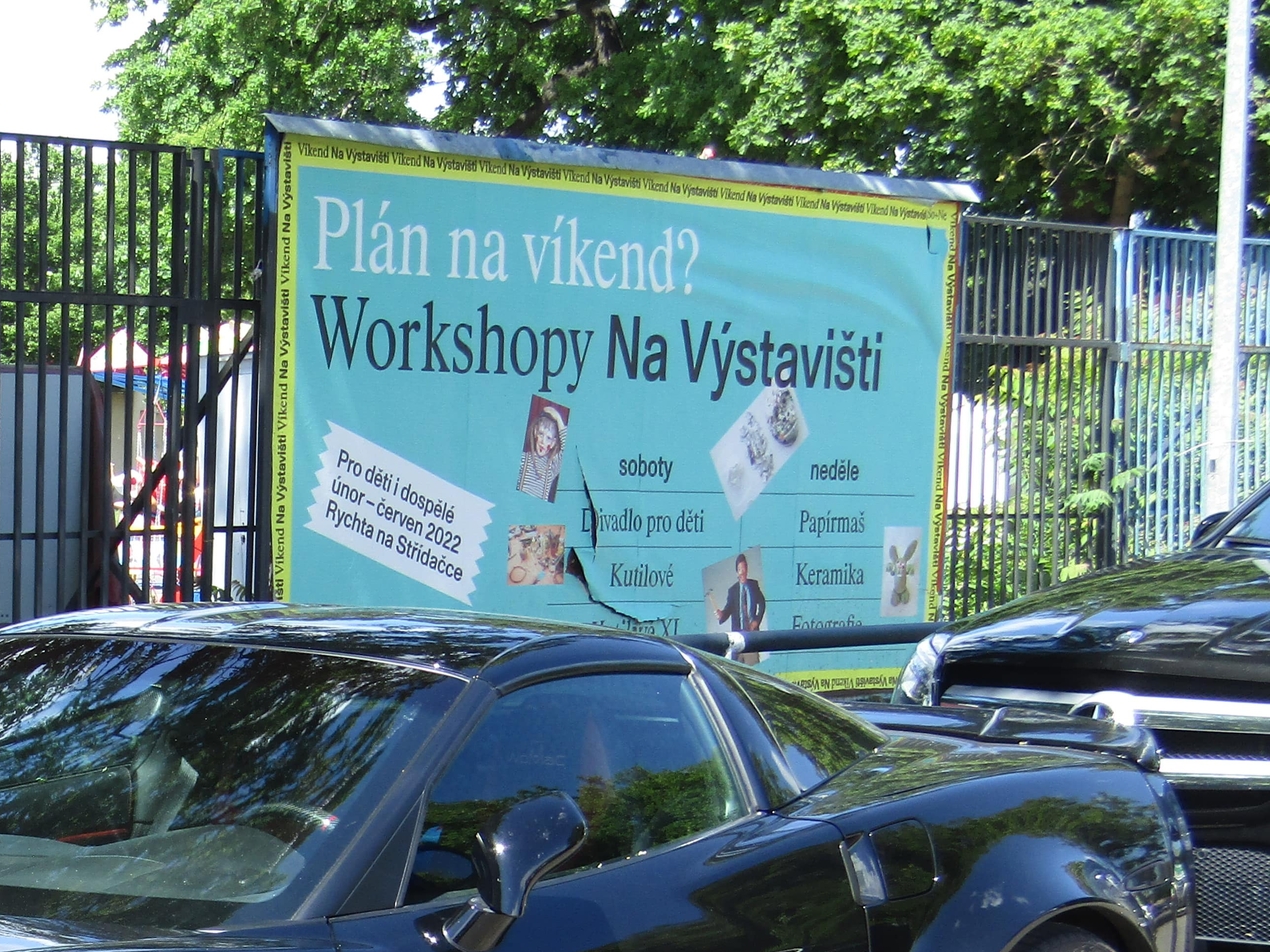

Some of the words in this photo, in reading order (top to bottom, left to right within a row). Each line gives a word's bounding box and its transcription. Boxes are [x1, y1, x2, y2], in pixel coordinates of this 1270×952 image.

[282, 141, 293, 210] Výstavišti
[298, 142, 329, 159] Víkend
[331, 146, 344, 160] Na
[345, 147, 390, 164] Výstavišti
[391, 151, 421, 168] Víkend
[423, 154, 436, 168] Na
[437, 156, 478, 172] Výstavišti
[479, 160, 507, 175] Víkend
[508, 163, 520, 176] Na
[521, 163, 561, 181] Výstavišti
[562, 168, 590, 184] Víkend
[591, 172, 603, 185] Na
[605, 174, 641, 189] Výstavišti
[642, 177, 669, 192] Víkend
[670, 181, 681, 194] Na
[682, 182, 718, 198] Výstavišti
[281, 214, 292, 233] Na
[280, 237, 291, 284] Víkend
[312, 195, 430, 277] Plán
[446, 228, 509, 282] na
[522, 214, 700, 295] víkend?
[280, 289, 291, 356] Výstavišti
[310, 294, 594, 394] Workshopy
[606, 314, 668, 382] Na
[680, 318, 884, 402] Výstavišti
[279, 360, 289, 379] Na
[277, 383, 288, 431] Víkend
[276, 435, 287, 501] Výstavišti
[336, 448, 363, 478] Pro
[364, 465, 394, 493] děti
[392, 477, 400, 497] i
[400, 483, 456, 524] dospělé
[619, 454, 673, 483] soboty
[810, 459, 860, 481] neděle
[276, 505, 285, 523] Na
[580, 507, 642, 533] Divadlo
[646, 513, 672, 538] pro
[676, 509, 704, 533] děti
[798, 509, 865, 537] Papírmaš
[274, 527, 285, 575] Víkend
[325, 500, 375, 540] Rychta
[376, 528, 395, 549] na
[395, 534, 464, 581] Střídačce
[424, 522, 463, 554] 2022
[609, 562, 674, 587] Kutilové
[795, 562, 864, 586] Keramika
[928, 612, 936, 622] N
